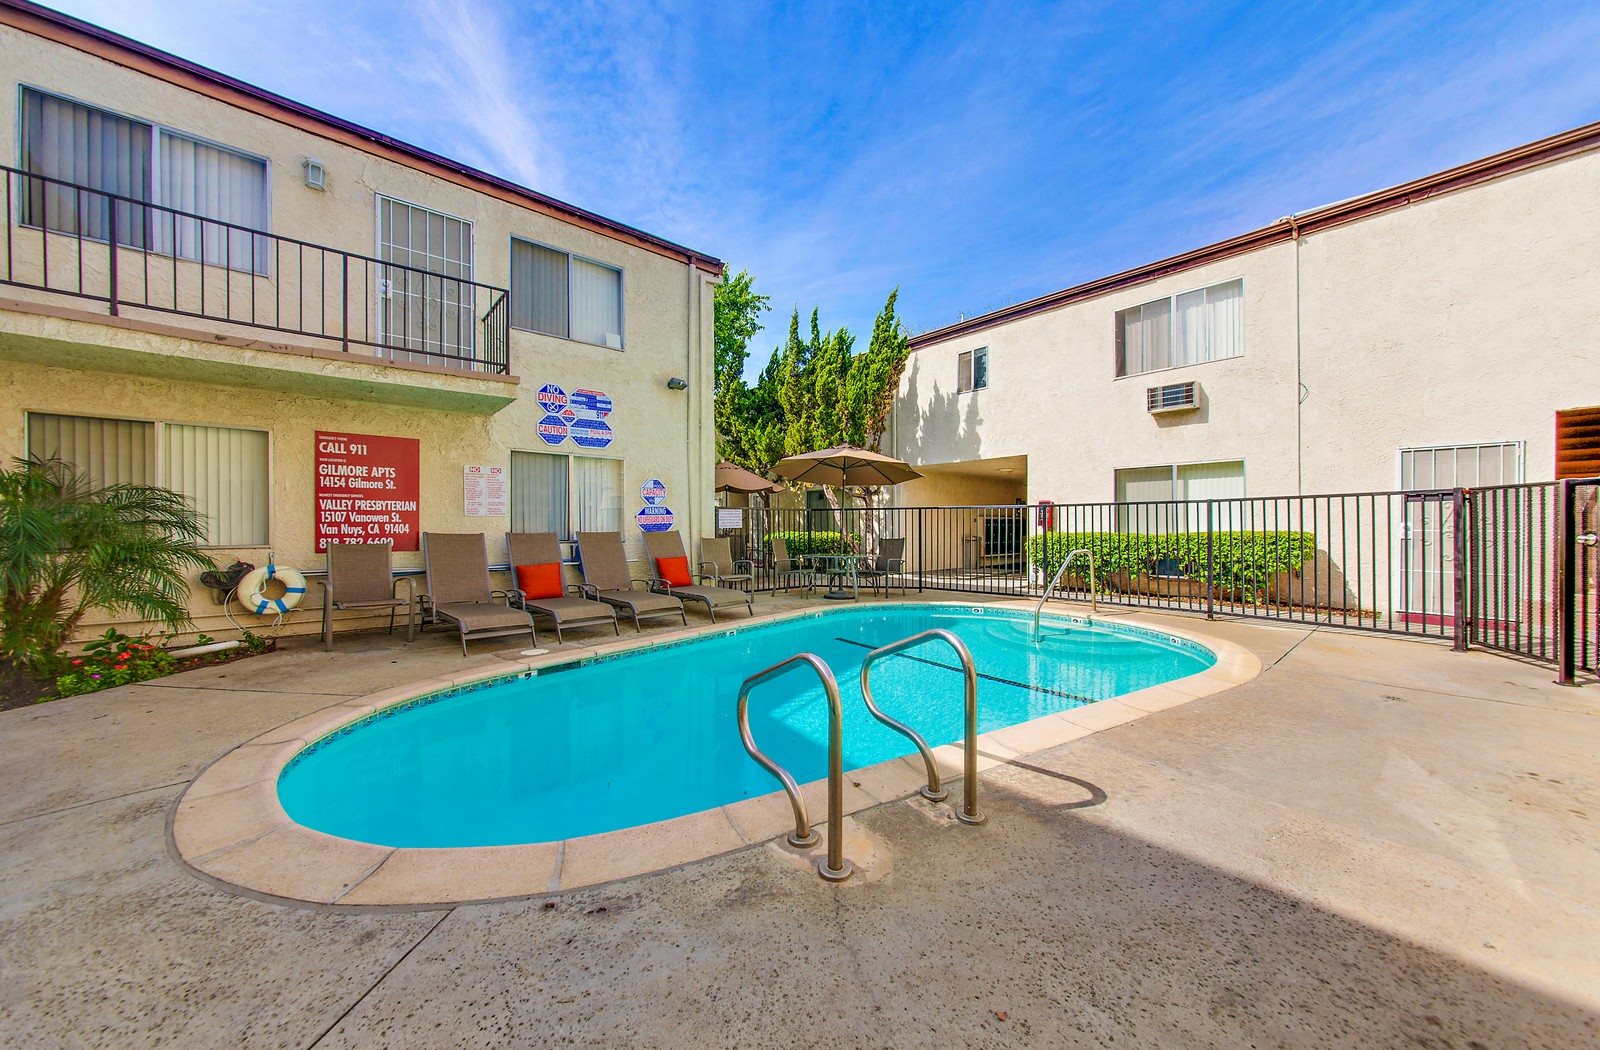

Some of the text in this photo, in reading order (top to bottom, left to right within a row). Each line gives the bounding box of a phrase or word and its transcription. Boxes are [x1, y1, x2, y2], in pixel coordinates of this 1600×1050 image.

[547, 384, 559, 394] NO
[538, 393, 568, 404] DIVING
[538, 425, 568, 435] CAUTION
[319, 442, 367, 456] CALL 911
[319, 464, 396, 478] GILMORE APTS
[320, 477, 396, 489] 14154 Gilmore St.
[320, 499, 416, 511] VALLEY PRESBYTERIAN
[320, 512, 402, 522] 15107 Vanowen St.
[320, 524, 409, 537] Van Nuys, CA 91404
